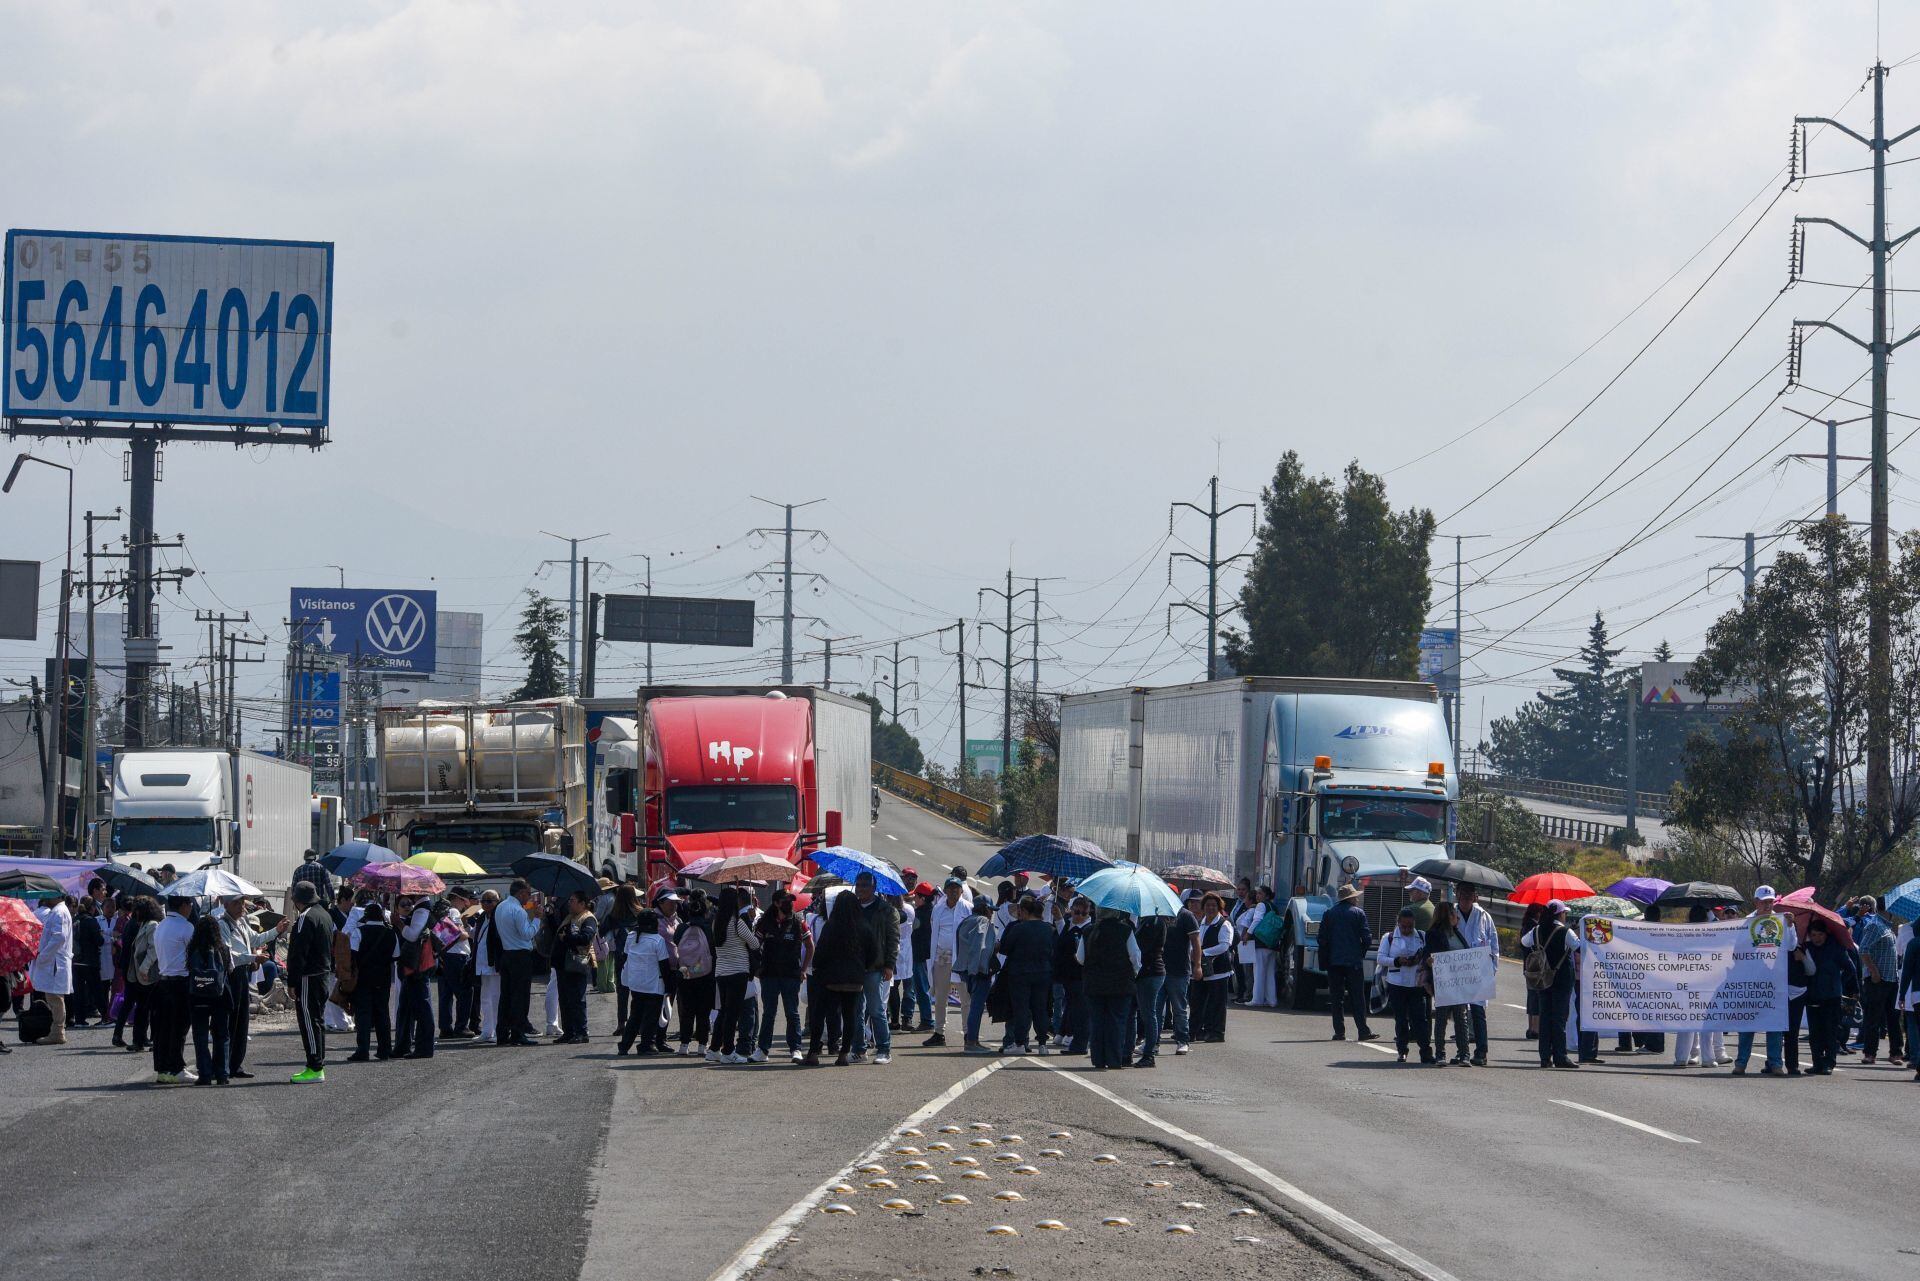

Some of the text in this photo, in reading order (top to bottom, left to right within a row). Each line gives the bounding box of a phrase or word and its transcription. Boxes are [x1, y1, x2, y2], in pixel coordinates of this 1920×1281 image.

[15, 280, 319, 413] 56464012
[299, 598, 356, 610] Visítanos
[709, 740, 754, 773] HP
[1605, 952, 1649, 960] EXIGIMOS
[1677, 953, 1702, 961] PAGO
[1732, 952, 1777, 960] NUESTRAS
[1593, 962, 1713, 972] PRESTACIONES COMPLETAS:
[1593, 971, 1645, 980] AGUINALDO
[1593, 981, 1776, 991] ESTÍMULOS DE ASISTENCIA,
[1592, 991, 1672, 999] RECONOCIMIENTO
[1688, 991, 1700, 1000] DE
[1592, 1000, 1776, 1011] PRIMA VACACIONAL, PRIMA DOMINICAL,
[1592, 1012, 1640, 1021] CONCEPTO
[1641, 1012, 1653, 1021] DE
[1655, 1013, 1688, 1021] RIESGO
